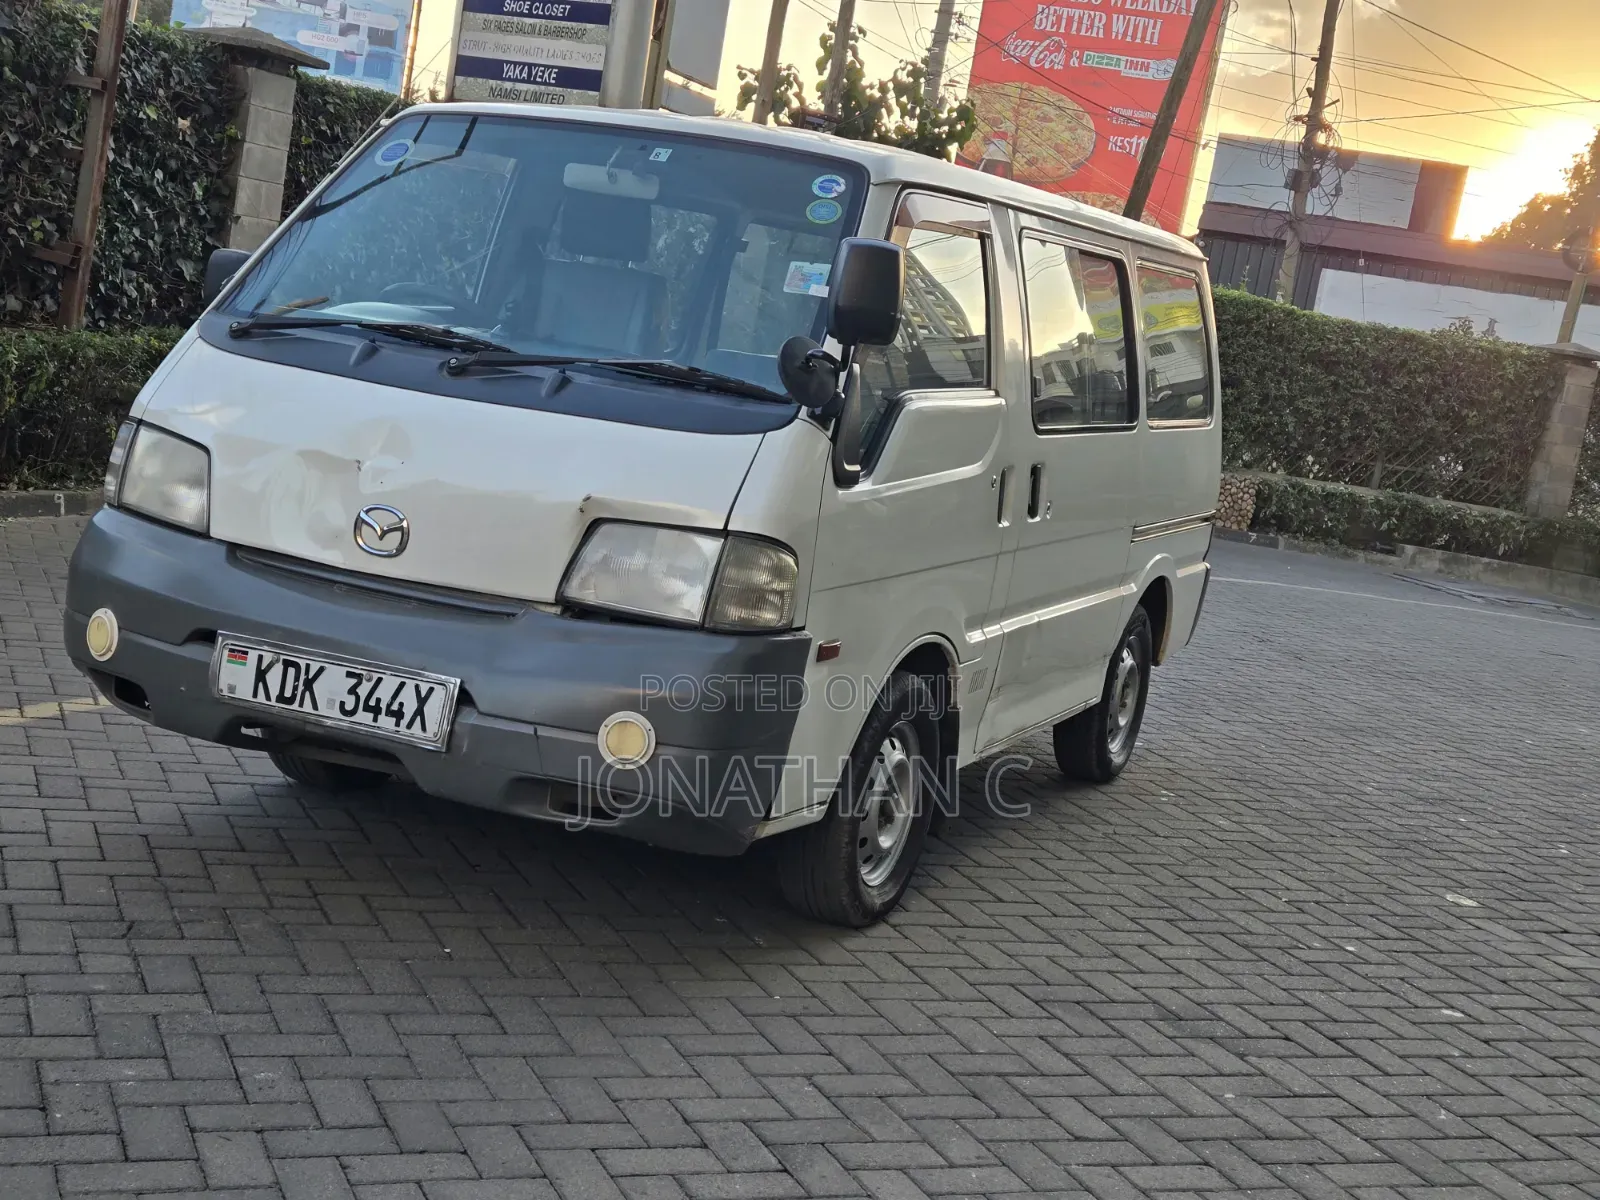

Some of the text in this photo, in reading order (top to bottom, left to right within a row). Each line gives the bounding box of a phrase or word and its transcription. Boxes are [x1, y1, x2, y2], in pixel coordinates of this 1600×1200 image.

[503, 0, 571, 17] SHOE CLOSET
[482, 19, 587, 40] SIX PAGES SALON & BARBERSHOP
[1033, 5, 1163, 45] BETTER WITH
[1069, 50, 1080, 67] &
[1084, 52, 1122, 69] PIZZA
[1124, 58, 1150, 73] INN
[502, 62, 558, 84] YAKA YEKE
[488, 86, 565, 105] NAMSI LIMITED
[252, 653, 326, 712] KDK
[338, 670, 436, 733] 344X
